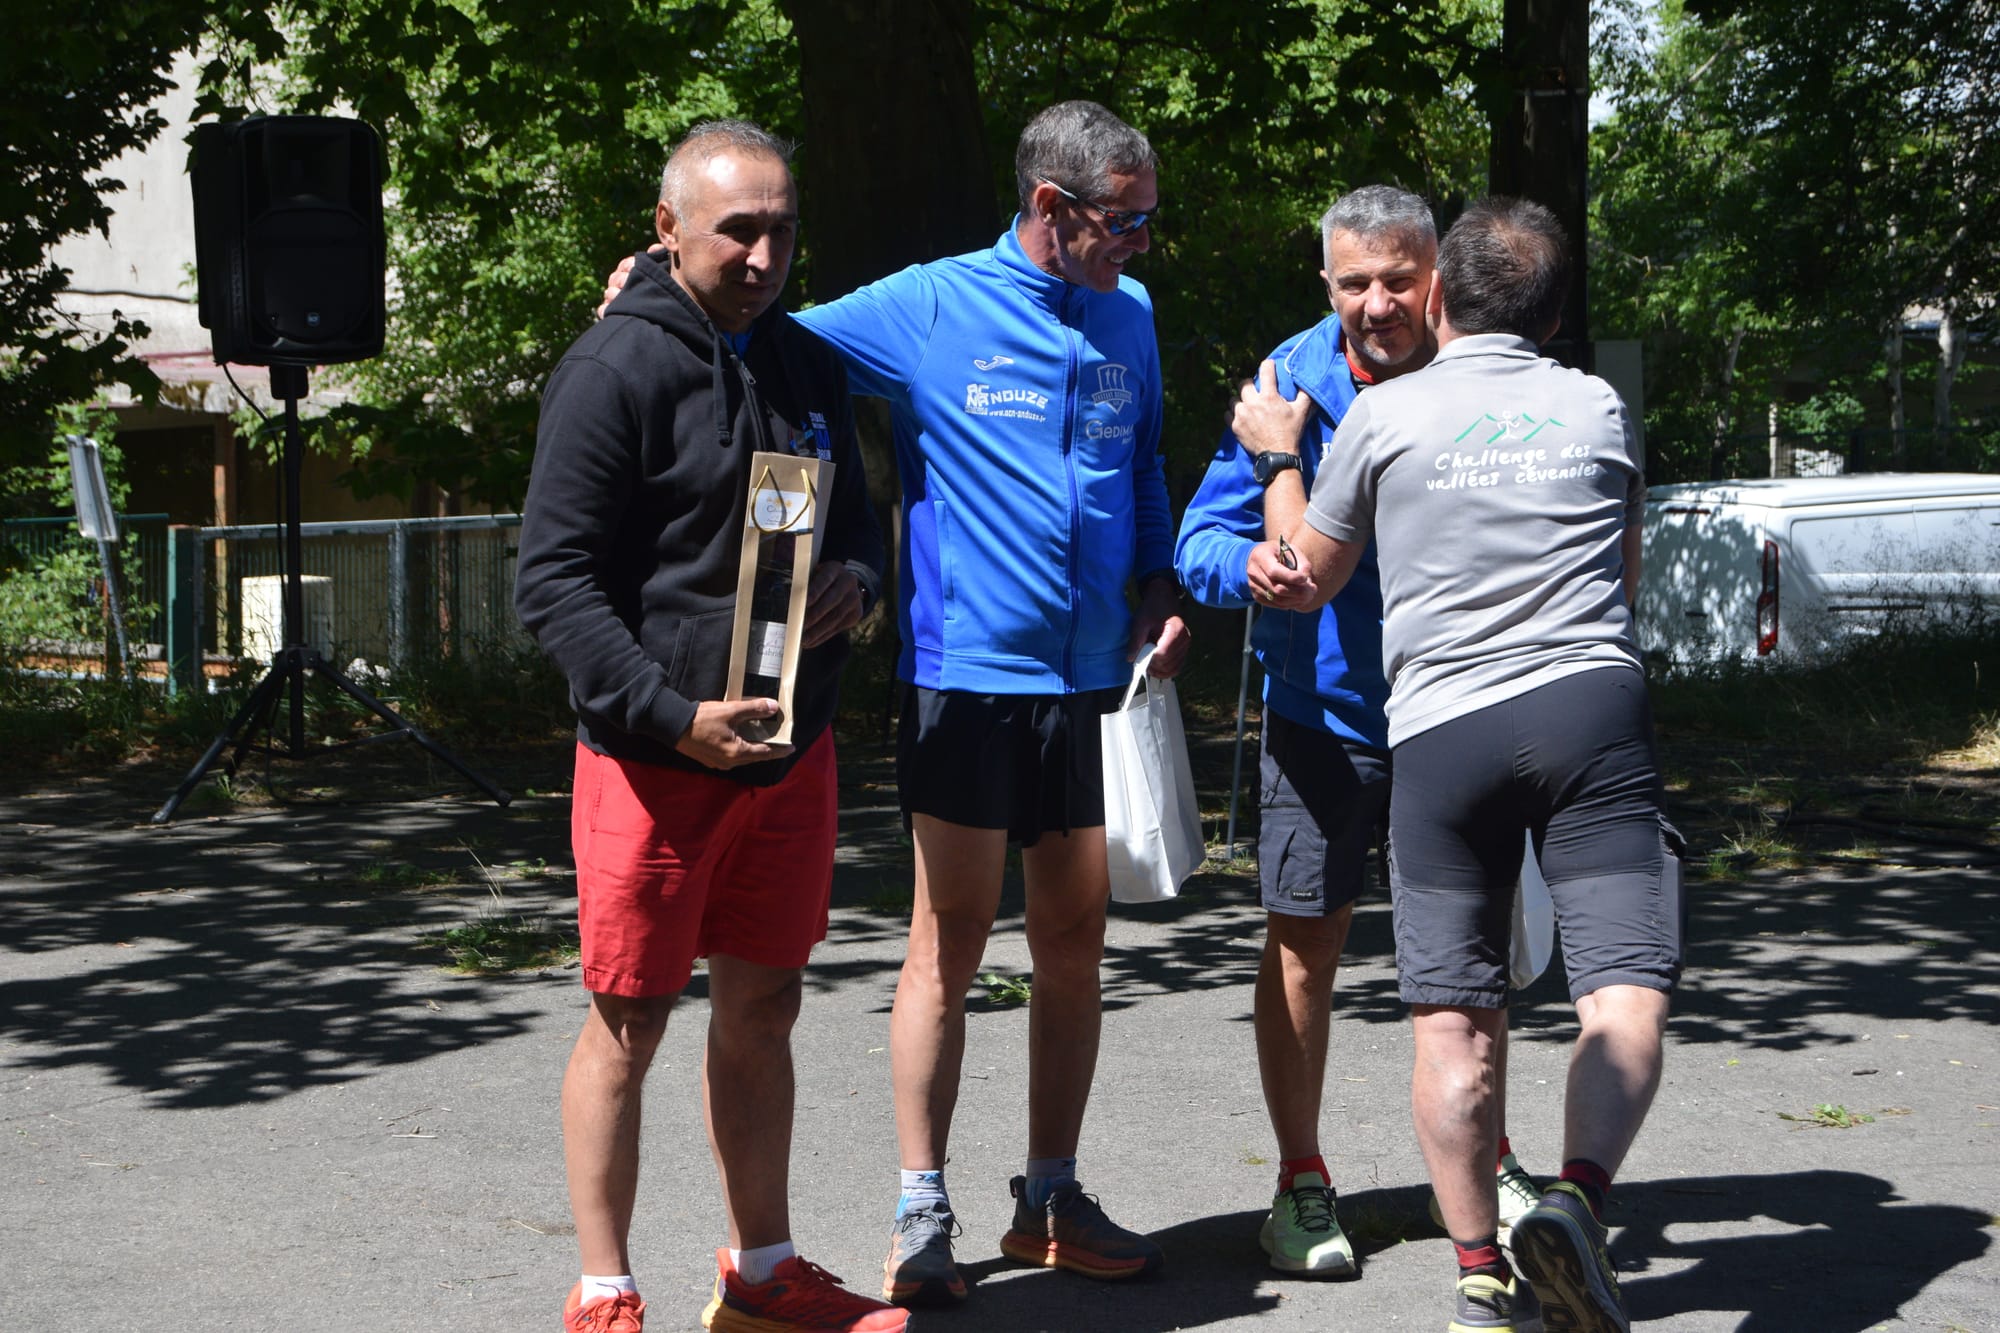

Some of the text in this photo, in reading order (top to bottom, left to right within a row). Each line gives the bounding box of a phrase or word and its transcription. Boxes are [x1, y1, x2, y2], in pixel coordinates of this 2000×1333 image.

[1434, 443, 1592, 471] Challenge des
[1426, 462, 1598, 490] vallées cévenoles
